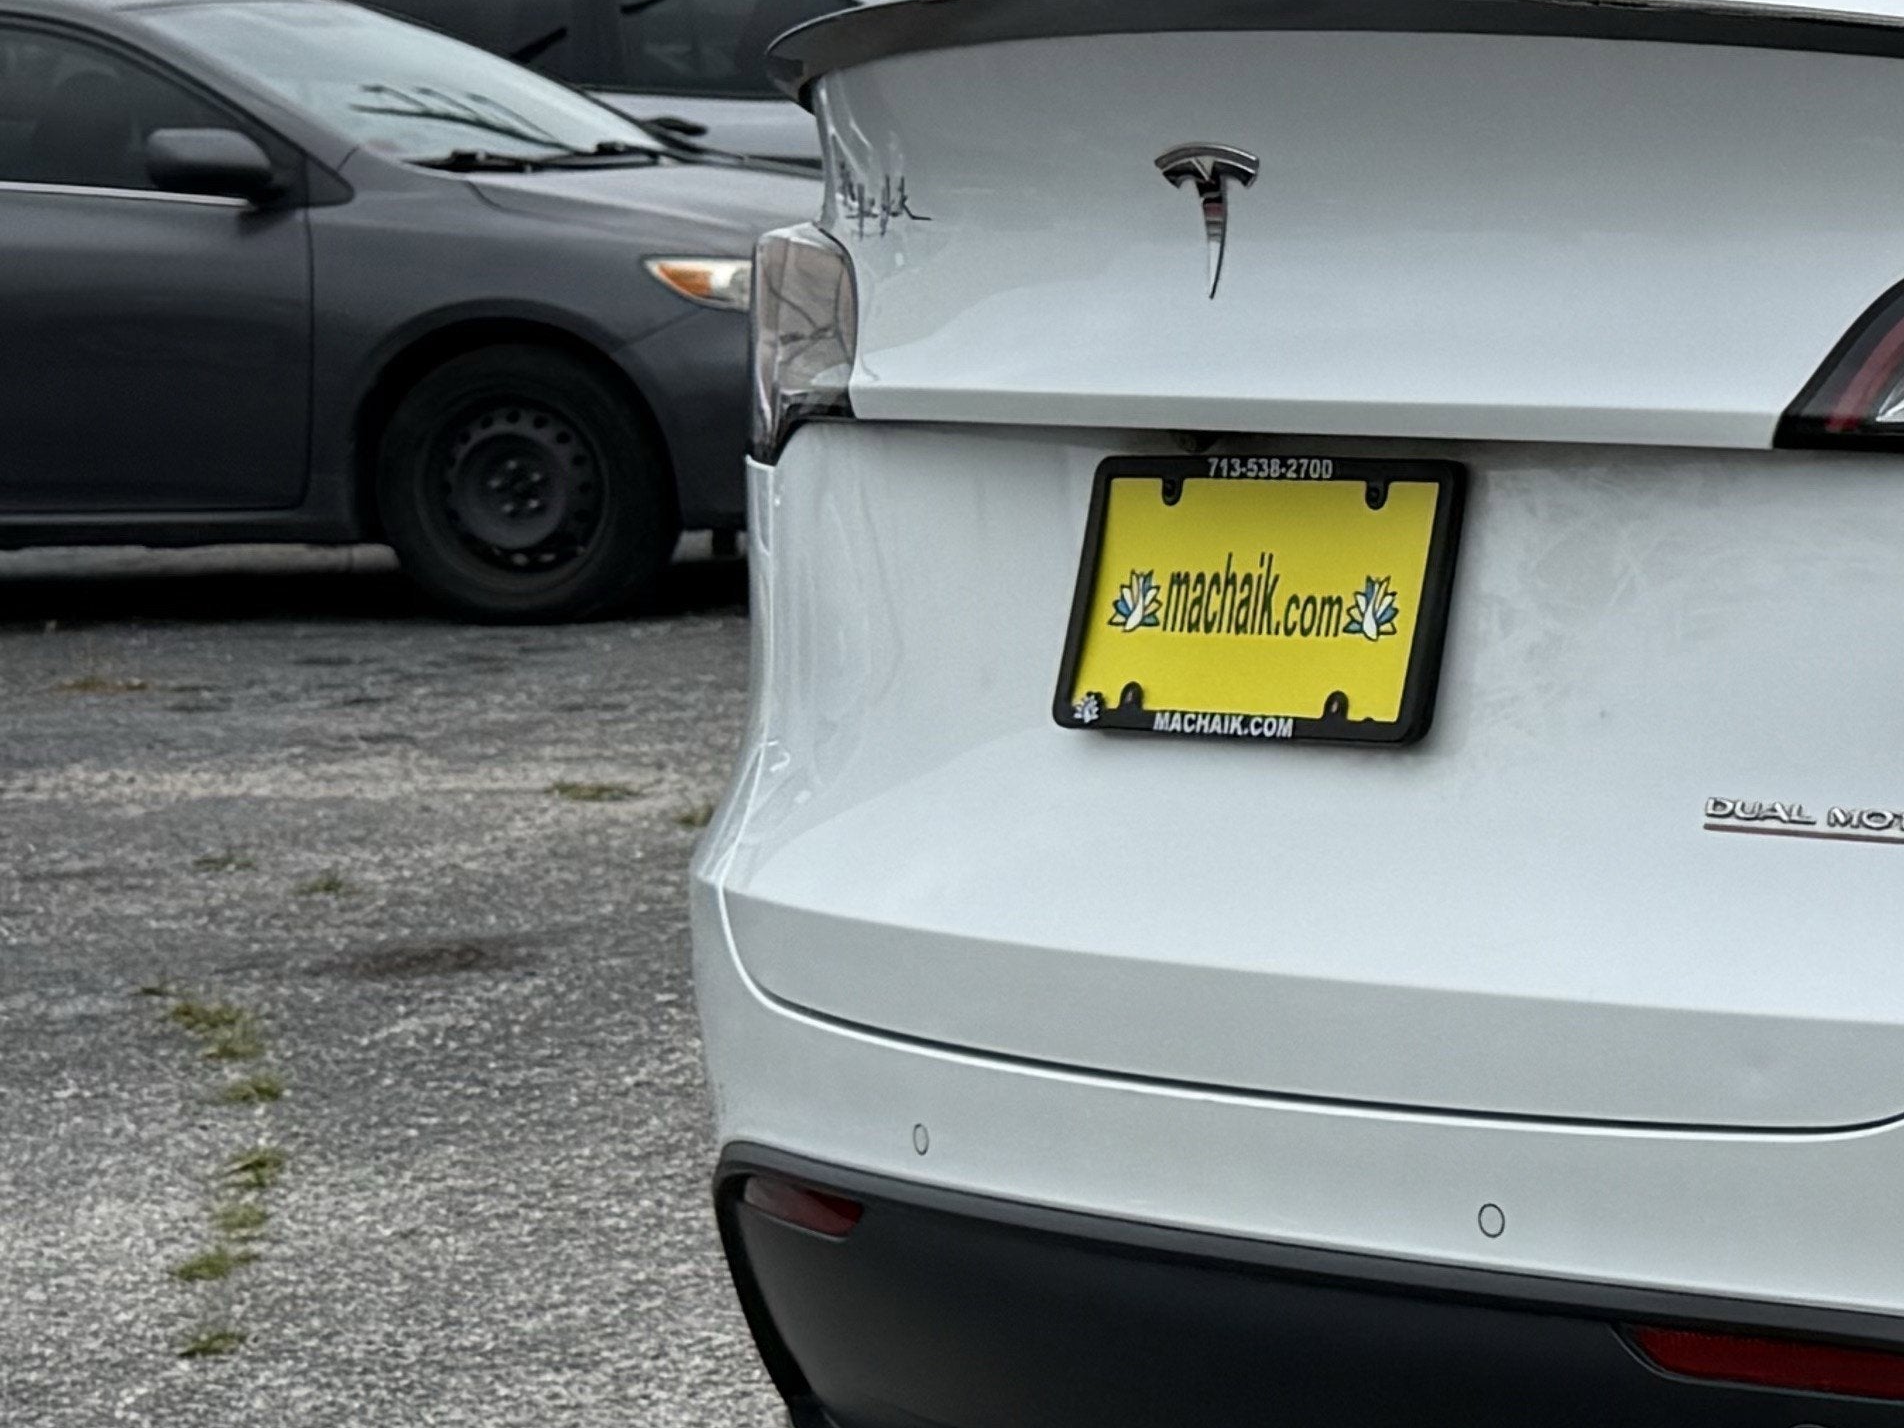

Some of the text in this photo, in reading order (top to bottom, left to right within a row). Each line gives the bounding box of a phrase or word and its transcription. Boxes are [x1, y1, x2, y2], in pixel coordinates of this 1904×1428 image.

[1162, 552, 1343, 637] machaik.com
[1153, 711, 1294, 738] MACHAIK.COM
[1705, 796, 1816, 825] DUAL
